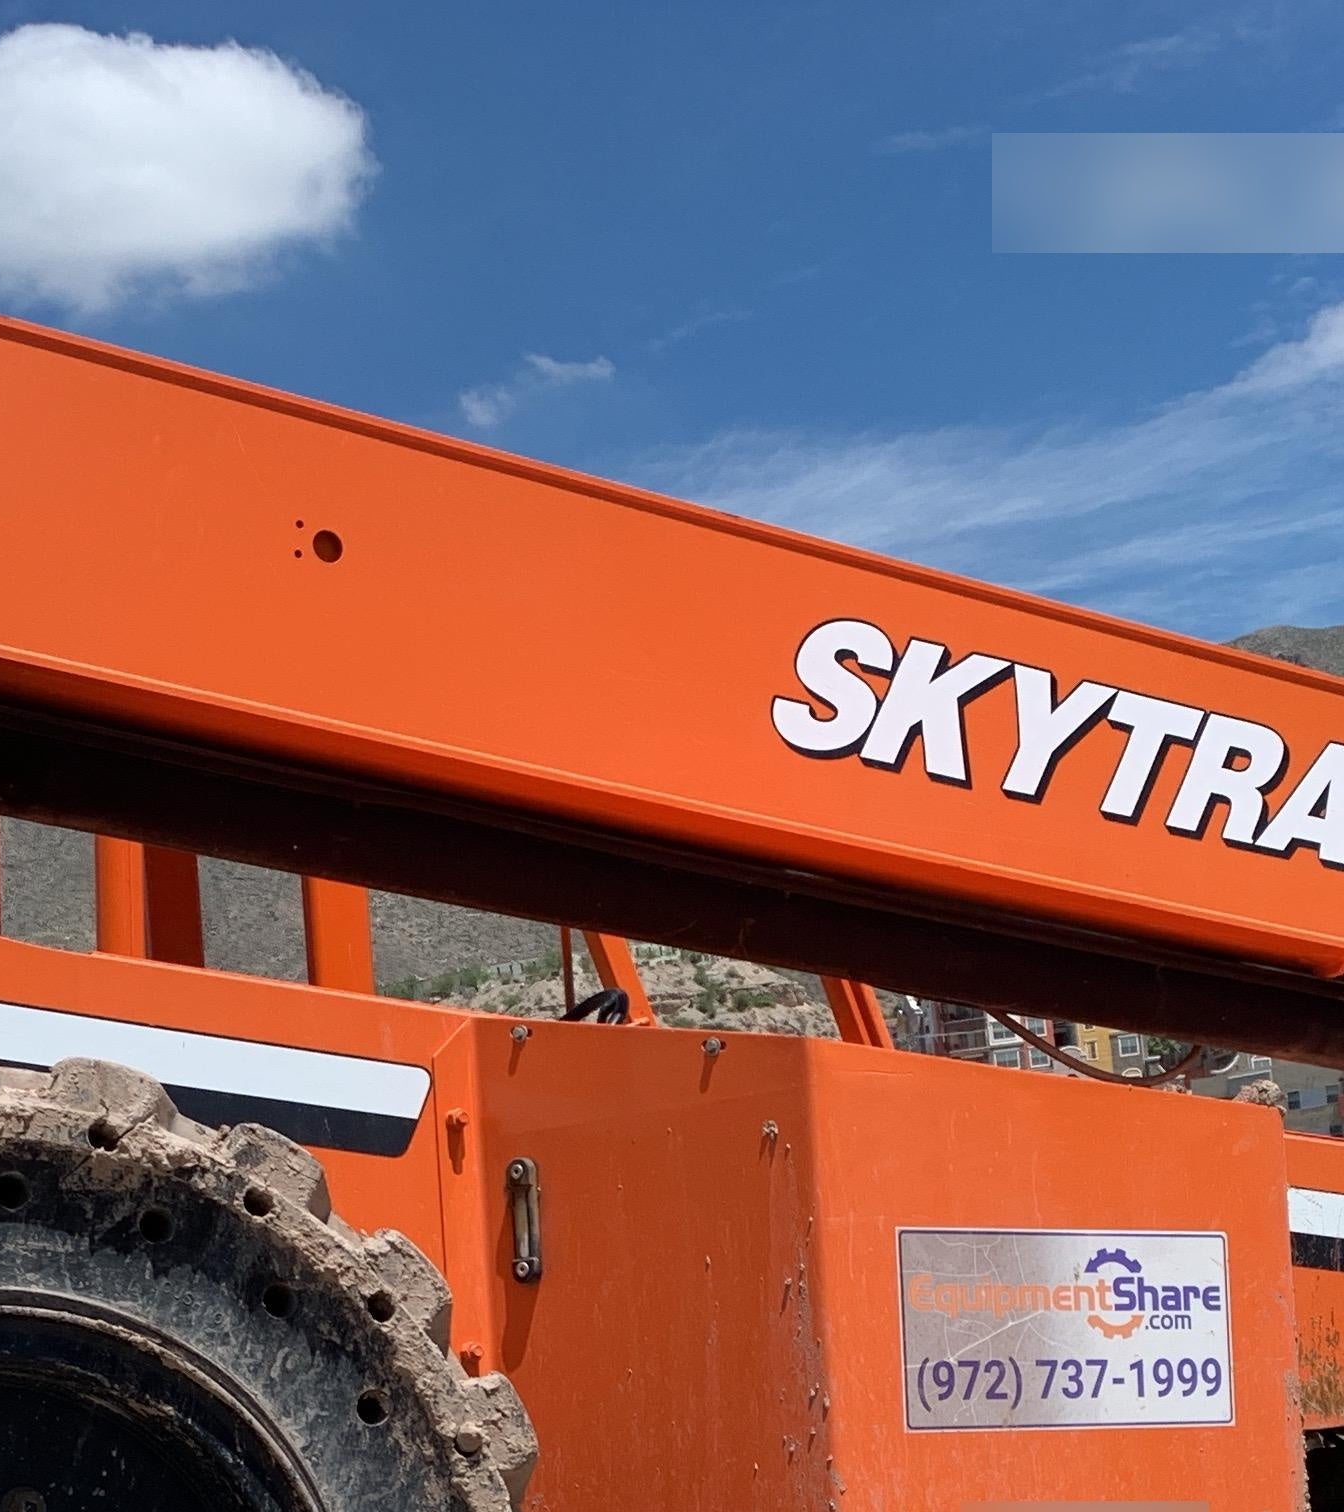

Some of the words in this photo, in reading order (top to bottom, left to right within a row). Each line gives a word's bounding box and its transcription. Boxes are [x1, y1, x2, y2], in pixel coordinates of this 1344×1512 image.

[909, 1274, 1221, 1318] EquipmentShare
[1144, 1312, 1193, 1331] .com
[917, 1356, 1024, 1413] (972)
[1035, 1357, 1223, 1401] 737-1999
